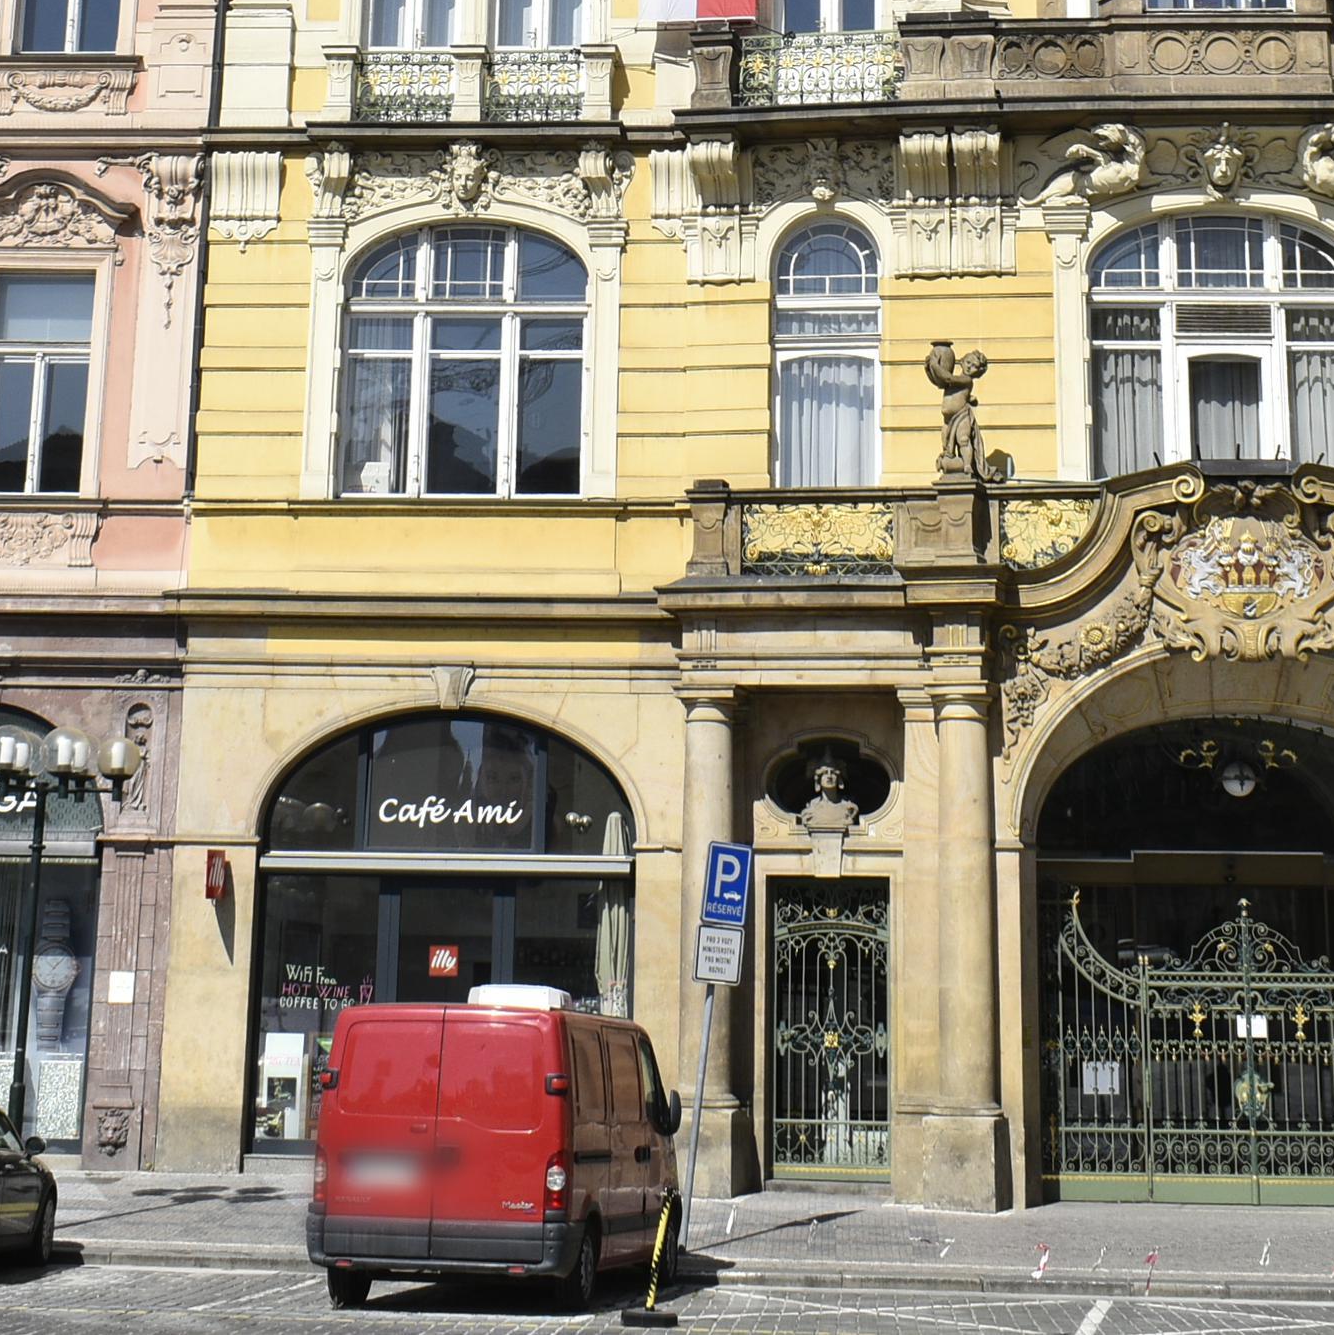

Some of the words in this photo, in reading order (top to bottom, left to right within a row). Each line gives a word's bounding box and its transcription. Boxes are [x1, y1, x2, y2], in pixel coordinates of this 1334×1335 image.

[378, 795, 451, 828] Café
[453, 799, 523, 824] Ami
[714, 853, 741, 898] P
[707, 902, 742, 917] RÉSERVÉ
[431, 949, 457, 973] illy
[282, 982, 311, 996] HOT
[316, 985, 351, 998] WINE
[279, 996, 318, 1010] COFFEE
[323, 998, 337, 1010] TO
[501, 1200, 534, 1210] Master
